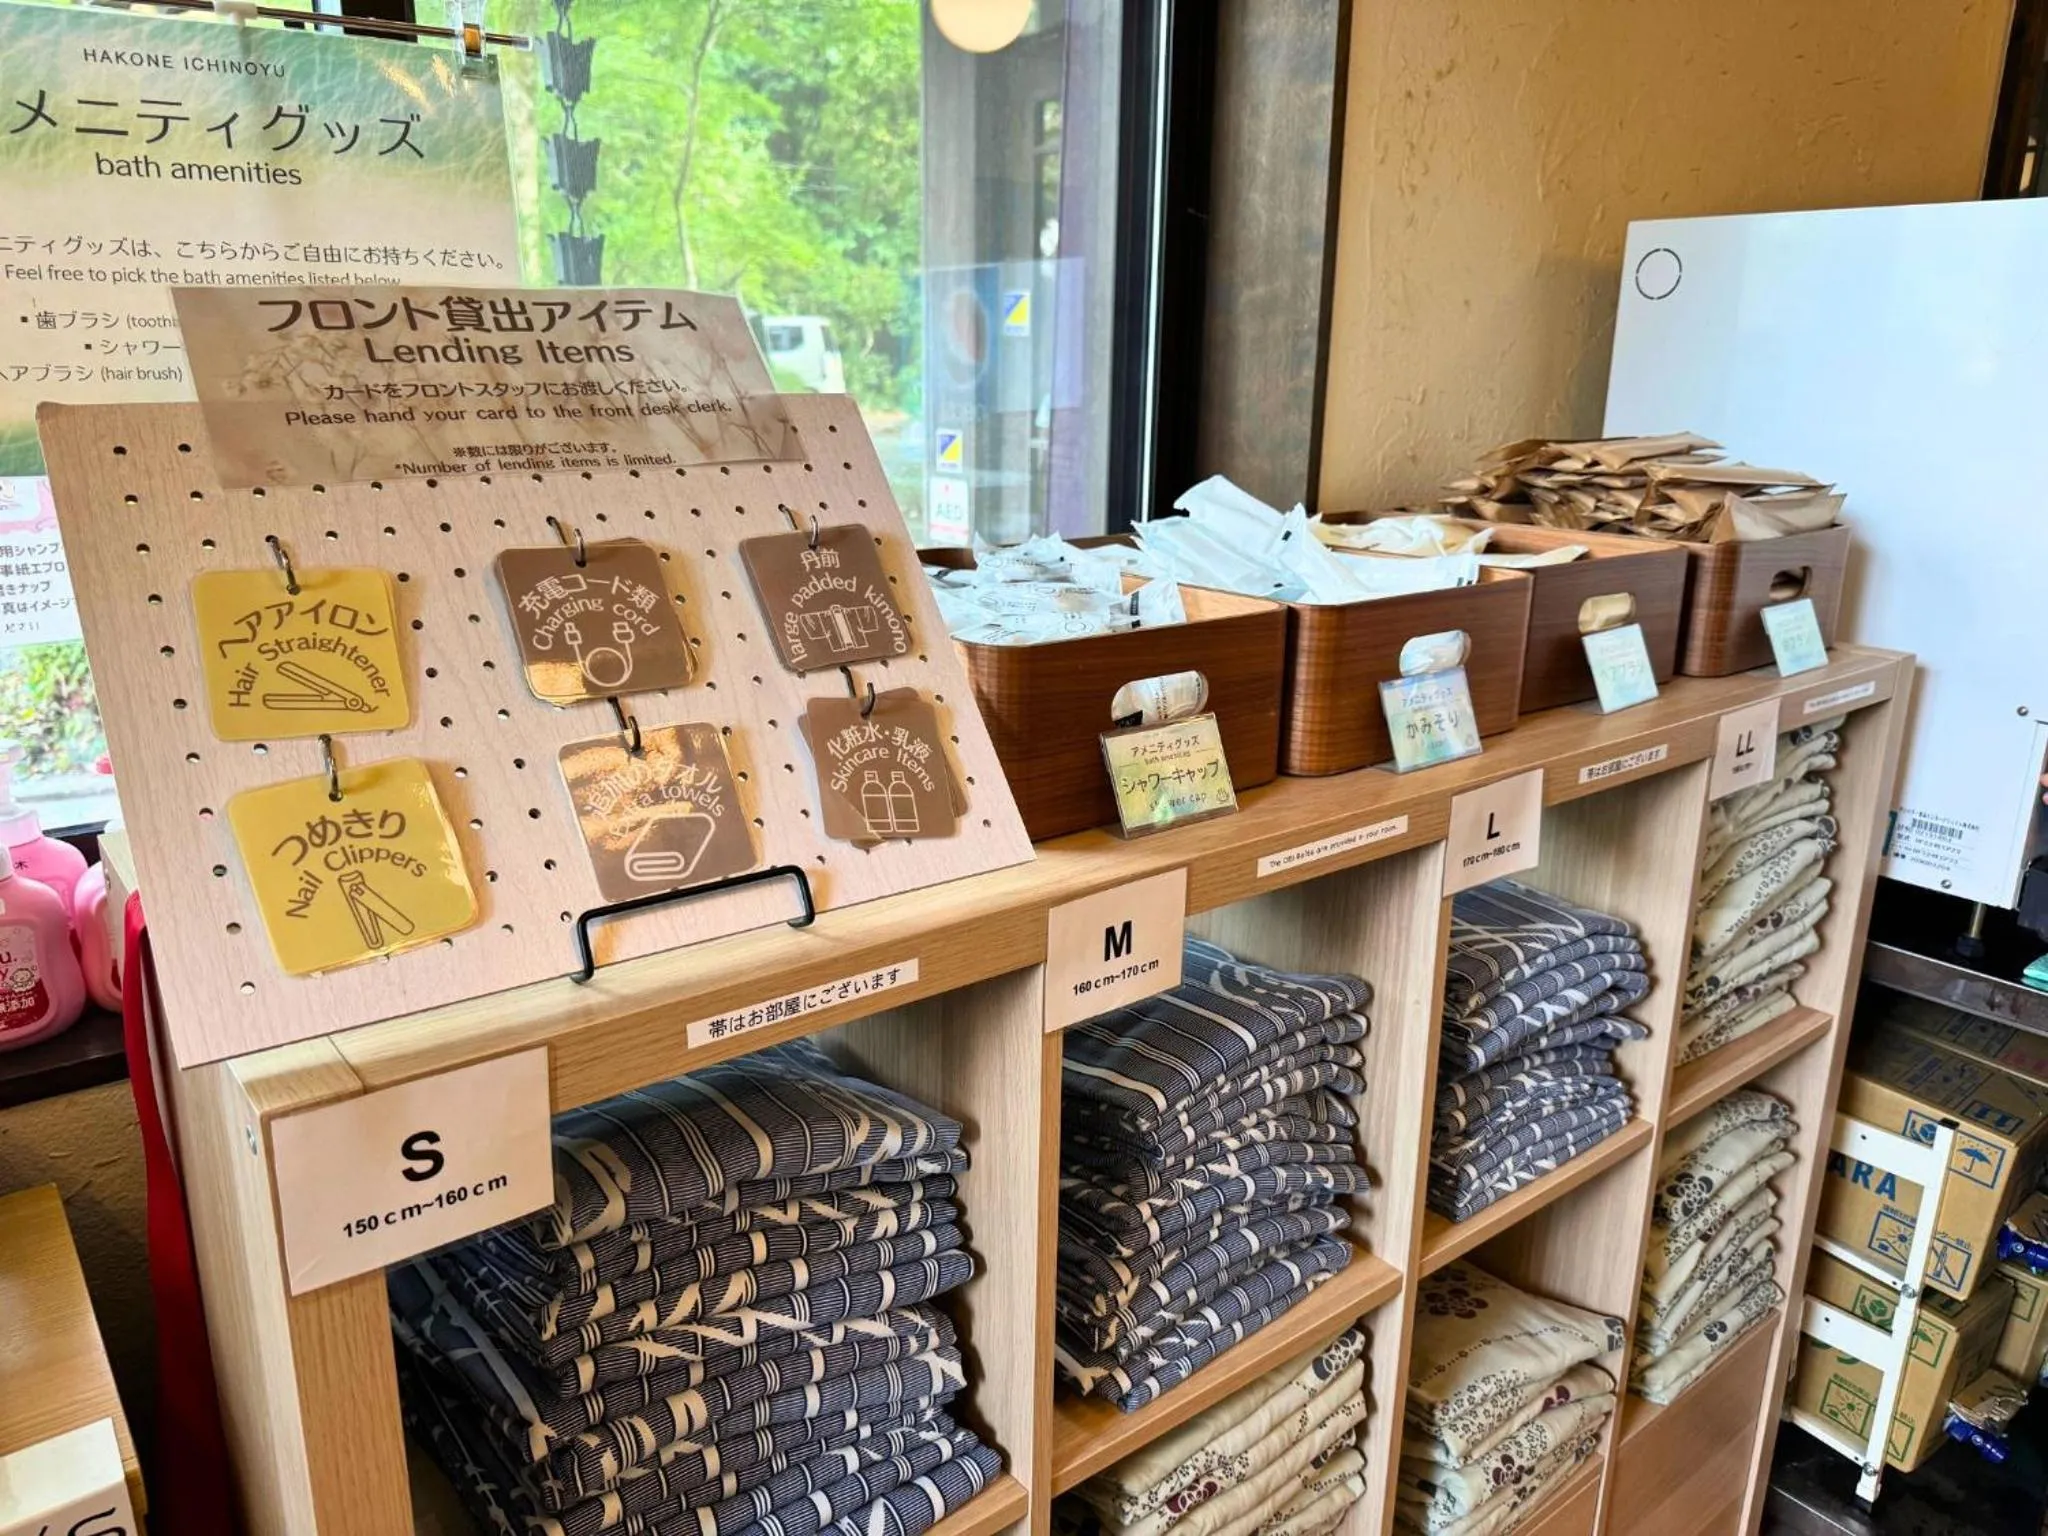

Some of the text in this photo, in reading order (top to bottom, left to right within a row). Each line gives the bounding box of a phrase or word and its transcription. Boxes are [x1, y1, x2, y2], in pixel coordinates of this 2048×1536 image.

[83, 48, 286, 78] HAKONE ICHINOYU
[10, 89, 425, 158] メニティグッズ
[95, 151, 303, 185] bath amenities
[5, 264, 42, 280] Feel
[49, 264, 84, 281] free
[89, 268, 107, 282] to
[112, 267, 147, 285] pick
[151, 267, 179, 283] the
[183, 269, 221, 284] bath
[226, 271, 304, 285] amenities
[308, 273, 349, 285] listed
[36, 310, 119, 330] 歯ブラシ
[257, 295, 698, 333] フロント貸出アイテム
[100, 339, 181, 355] シャワー
[364, 336, 635, 365] Lending Items
[101, 366, 132, 383] (hair
[136, 366, 183, 383] brush)
[324, 377, 689, 401] カードをフロントスタッフにお渡しください。
[285, 398, 732, 426] Please hand your card to the front desk clerk.
[475, 459, 492, 473] of
[498, 453, 555, 470] lending
[561, 455, 600, 468] items
[607, 456, 620, 467] is
[624, 453, 676, 469] limited.
[800, 547, 841, 572] 丹前
[518, 573, 660, 620] 充電コード類
[218, 598, 389, 659] ヘアアイロン
[532, 596, 661, 650] Charging cord
[785, 571, 907, 663] large padded kimono
[228, 631, 391, 707] Hair Straightener
[1406, 711, 1459, 739] かみそり
[1735, 729, 1755, 757] LL
[830, 745, 935, 793] Skincare Items
[1120, 759, 1219, 795] シャワーキャップ
[661, 784, 726, 818] towels
[271, 808, 406, 866] つめきり
[1487, 812, 1500, 840] L
[285, 844, 428, 919] Nail Clippers
[1104, 920, 1132, 962] M
[708, 967, 902, 1039] 帯はお部屋にございます
[401, 1130, 445, 1182] S
